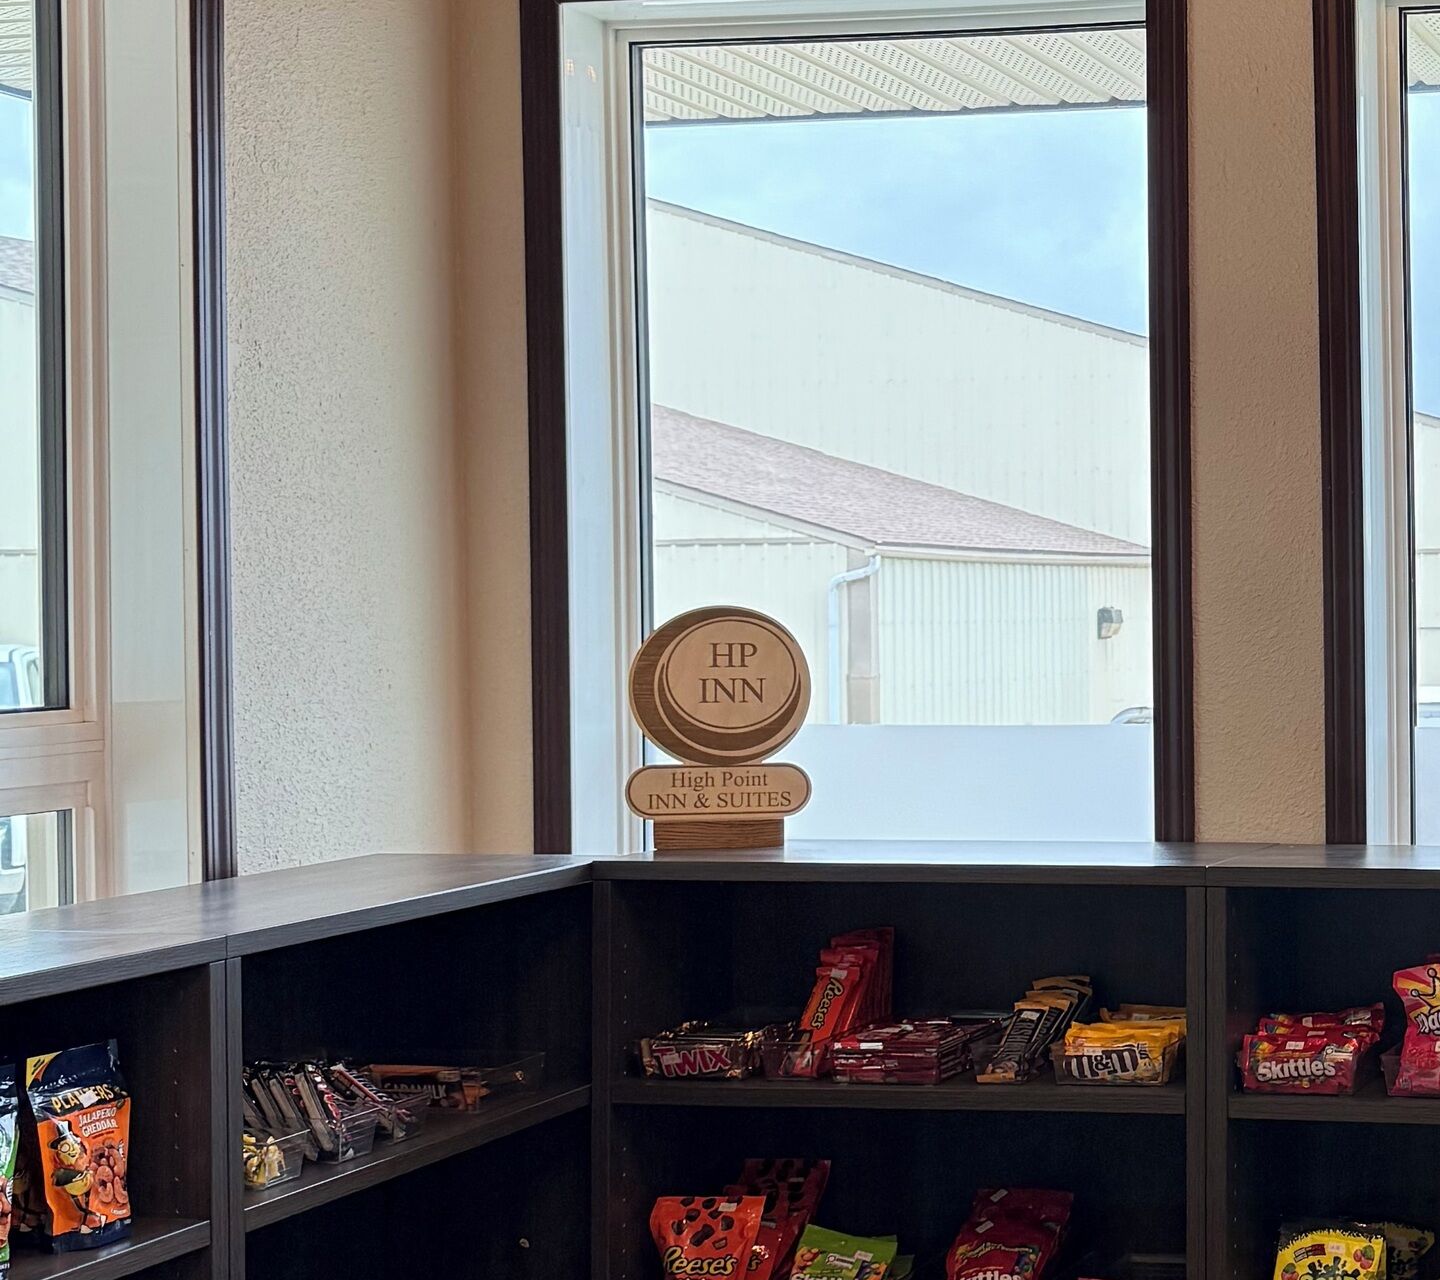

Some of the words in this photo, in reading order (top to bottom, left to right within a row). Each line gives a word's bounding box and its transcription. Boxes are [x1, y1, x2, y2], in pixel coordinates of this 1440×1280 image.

[708, 642, 758, 668] HP
[698, 677, 767, 705] INN
[671, 771, 715, 792] High
[721, 770, 769, 788] Point
[648, 794, 688, 810] INN
[693, 792, 711, 809] &
[716, 791, 793, 809] SUITES
[1256, 1057, 1336, 1082] Skittles
[663, 1245, 738, 1277] Reese's
